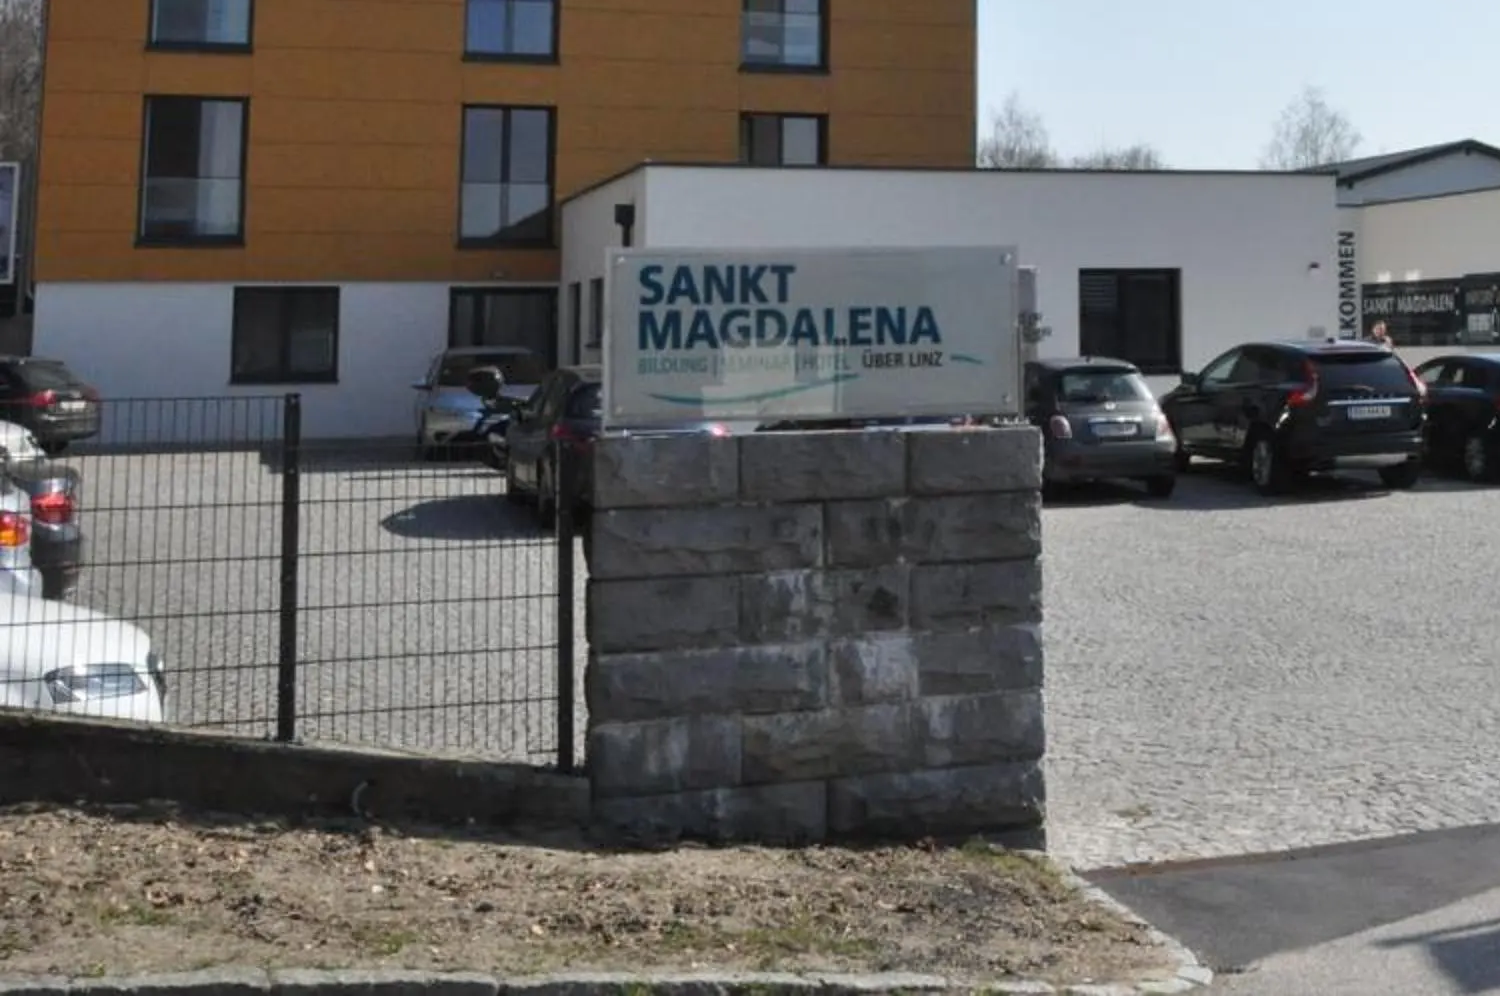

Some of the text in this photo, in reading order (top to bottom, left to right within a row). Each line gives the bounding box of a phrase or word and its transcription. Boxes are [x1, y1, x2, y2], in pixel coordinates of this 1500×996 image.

[638, 264, 796, 305] SANKT
[638, 306, 942, 350] MAGDALENA
[637, 354, 709, 374] BILDUNG
[803, 354, 851, 371] HOTEL
[862, 350, 904, 368] ÜBER
[909, 351, 944, 367] LINZ
